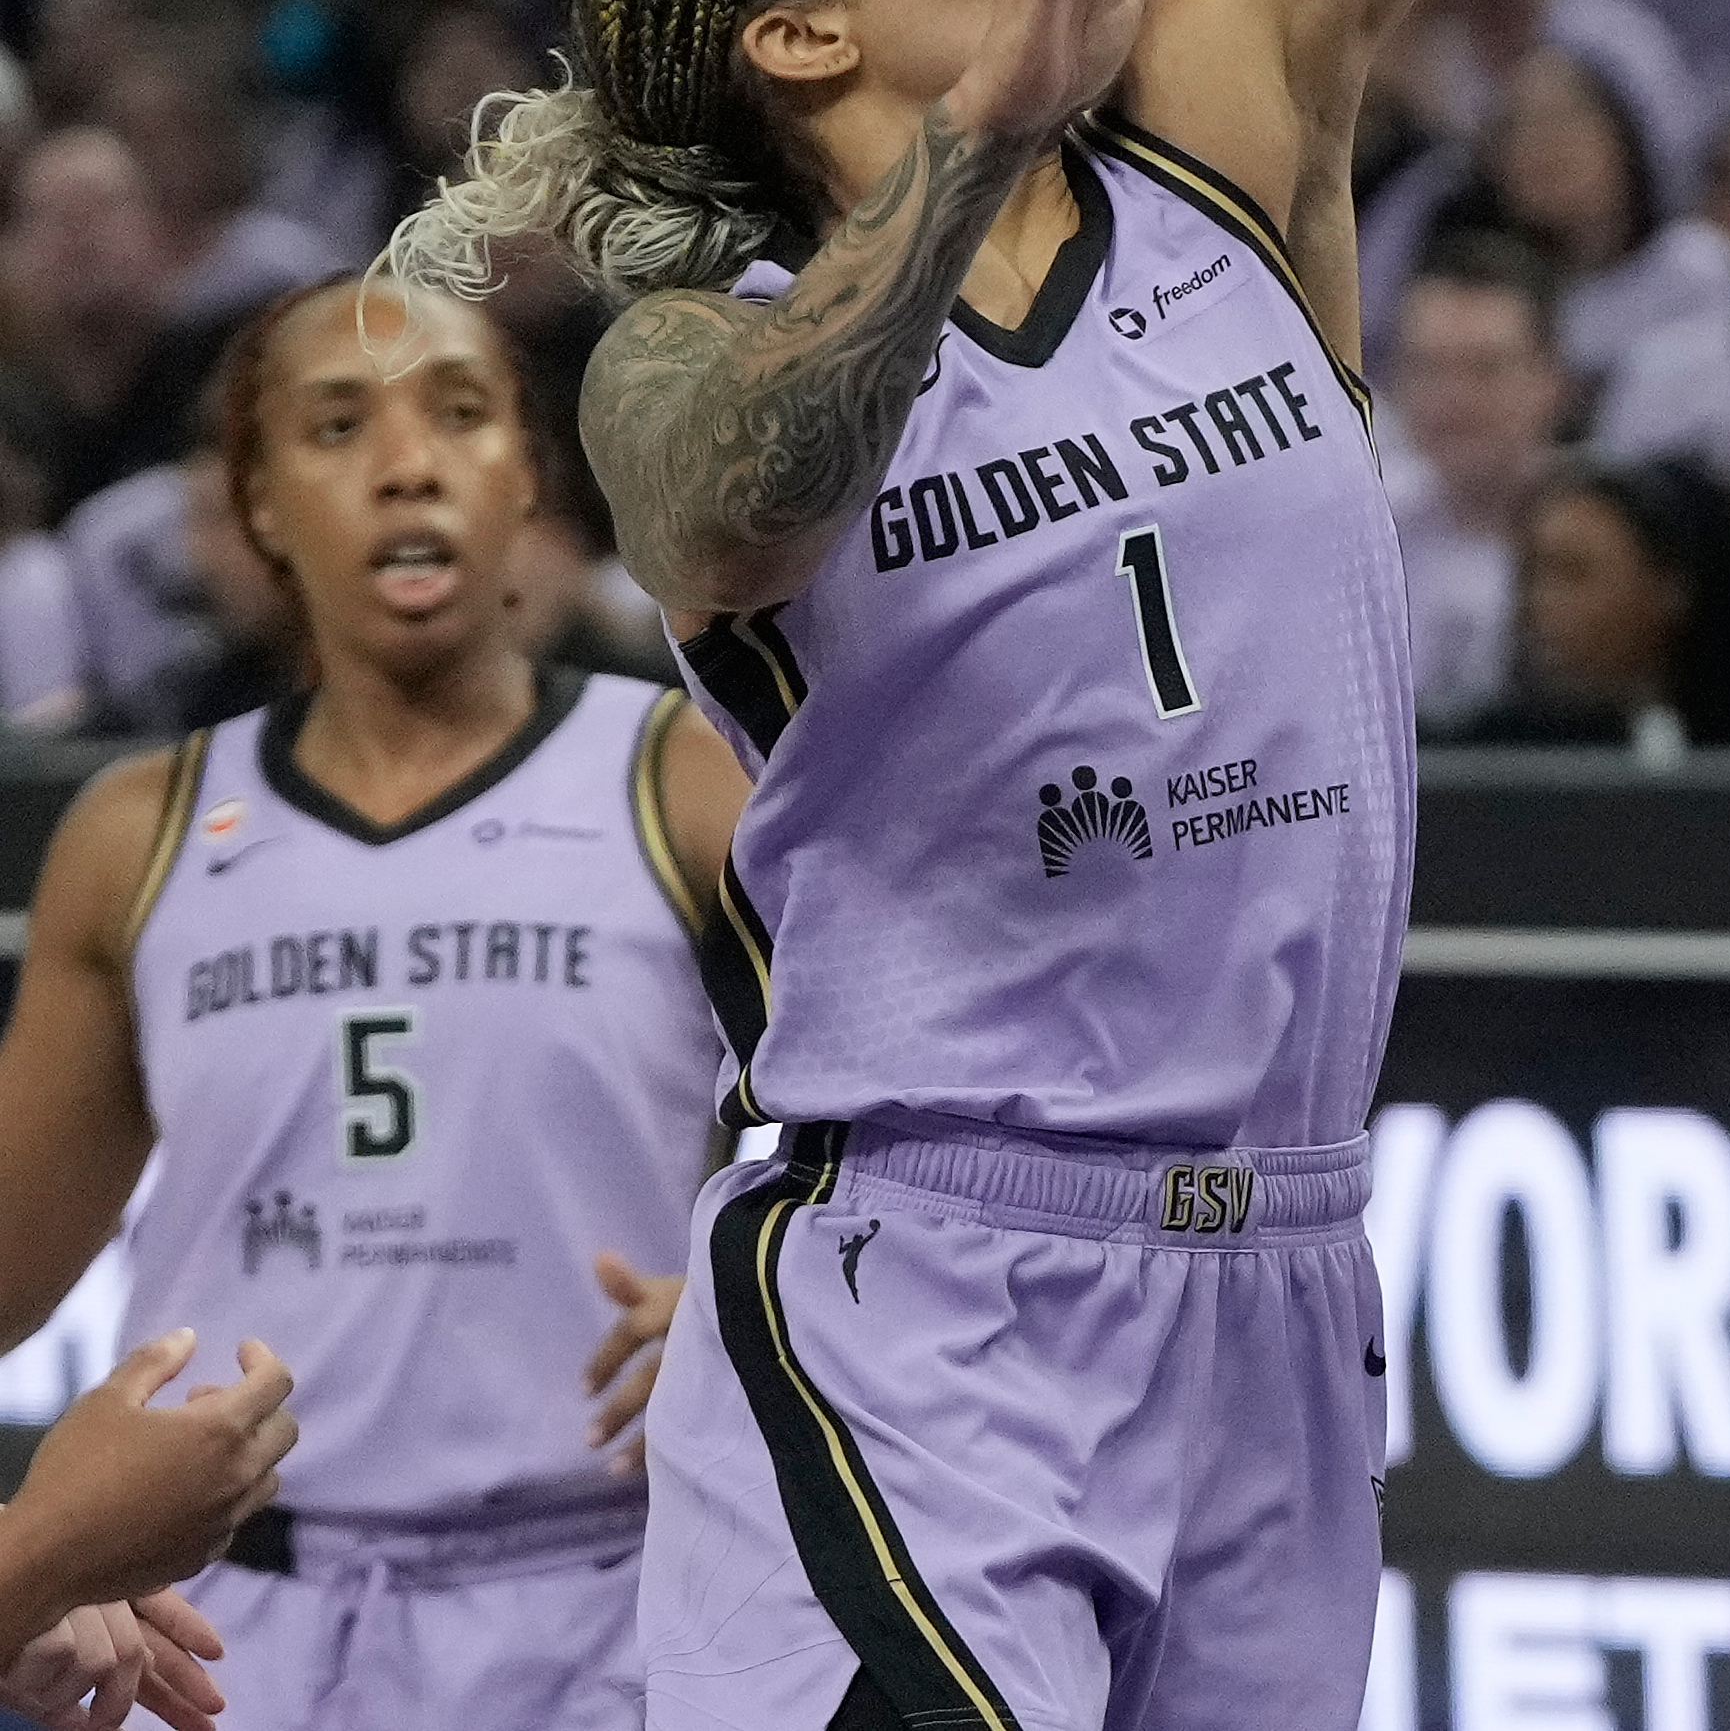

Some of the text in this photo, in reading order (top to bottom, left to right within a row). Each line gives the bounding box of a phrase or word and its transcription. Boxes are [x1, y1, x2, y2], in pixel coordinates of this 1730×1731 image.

[1152, 253, 1232, 320] freedom
[871, 362, 1322, 573] GOLDEN STATE
[1114, 523, 1202, 721] 1
[1166, 759, 1258, 809] KAISER
[1171, 784, 1350, 851] PERMANENTE
[186, 920, 594, 1022] GOLDEN STATE
[340, 1008, 418, 1161] 5
[1160, 1164, 1255, 1234] GSV
